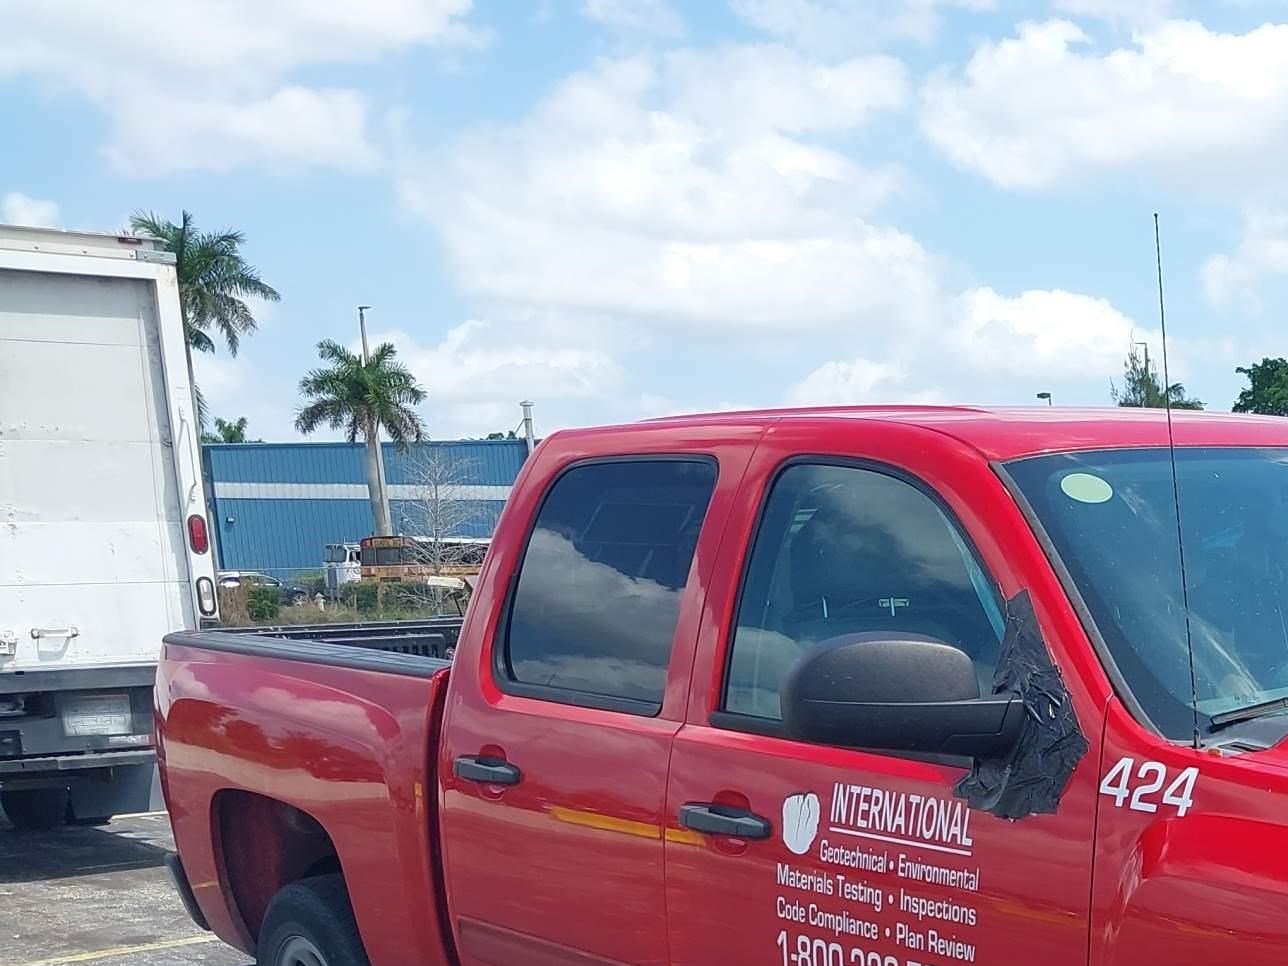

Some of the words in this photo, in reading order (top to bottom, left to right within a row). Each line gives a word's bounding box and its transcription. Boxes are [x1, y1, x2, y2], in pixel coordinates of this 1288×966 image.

[829, 782, 973, 847] INTERNATIONAL
[1099, 756, 1200, 818] 424
[776, 863, 833, 896] Materials
[836, 875, 883, 912] Testing
[899, 888, 977, 926] Inspections
[819, 839, 887, 873] Geotechnical
[897, 854, 980, 891] Environmental
[776, 896, 806, 923] Code
[808, 903, 879, 939] Compliance
[896, 922, 924, 951] Plan
[927, 930, 976, 962] Review
